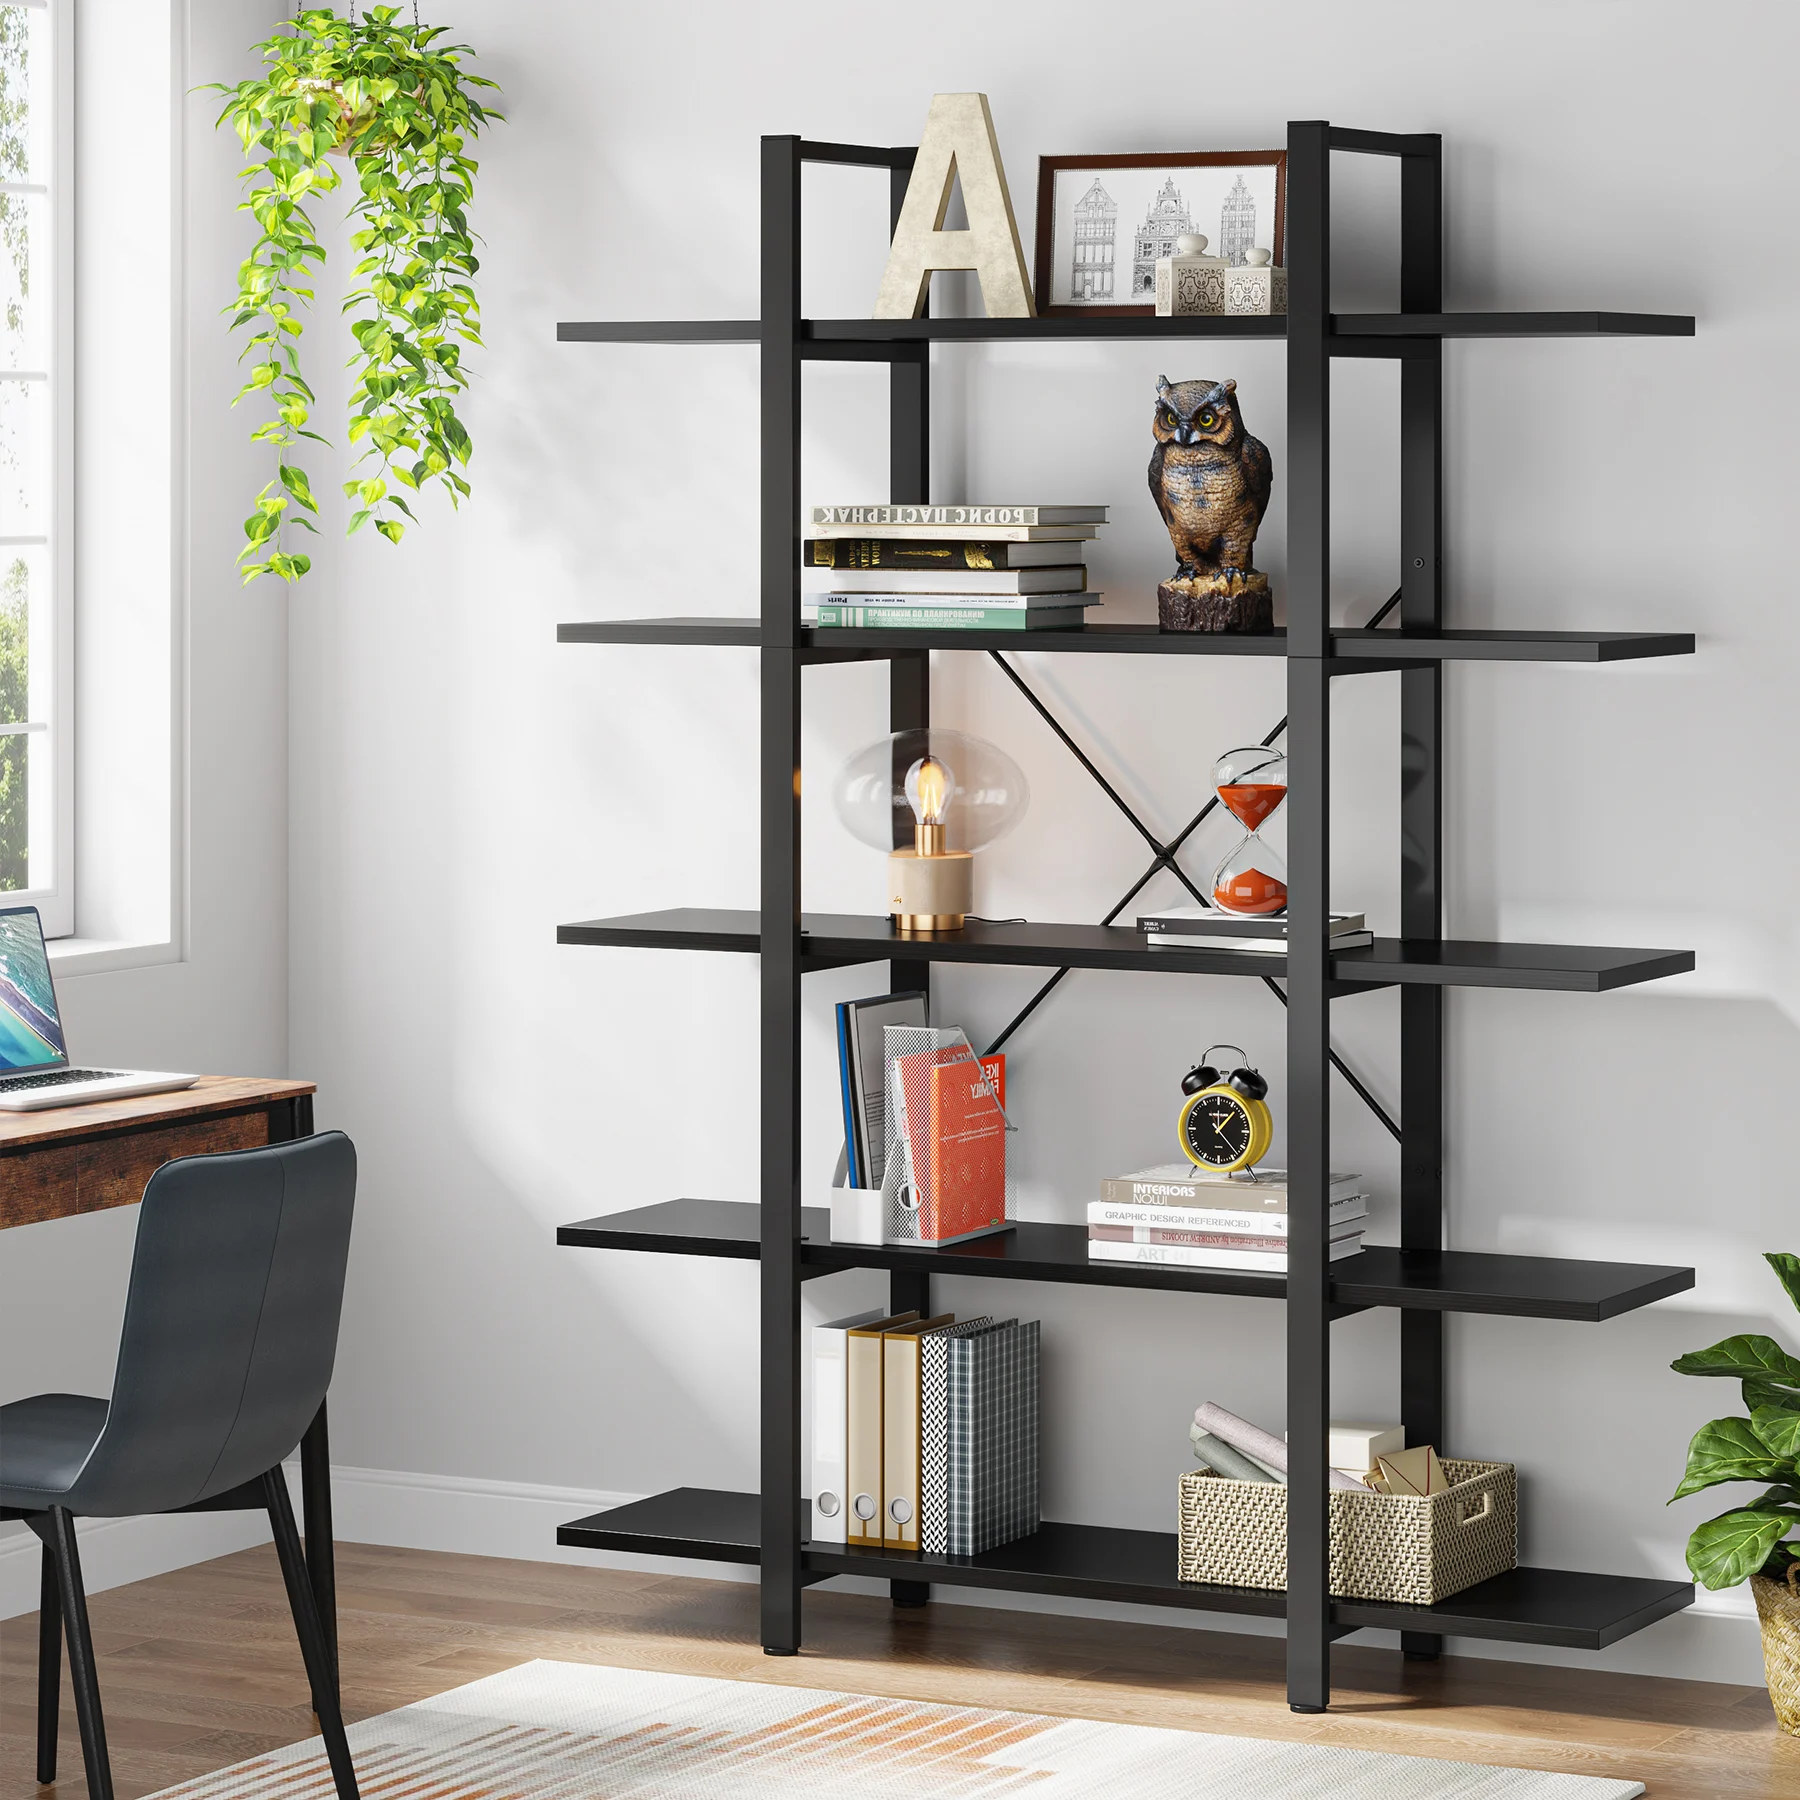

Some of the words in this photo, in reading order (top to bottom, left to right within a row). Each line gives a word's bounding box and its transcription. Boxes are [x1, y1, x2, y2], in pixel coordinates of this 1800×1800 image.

[872, 93, 1037, 318] A
[821, 508, 947, 523] ПАСТЕРНАК
[955, 508, 1025, 523] БОРИС
[868, 609, 911, 617] ПРАКТИКУМ
[912, 609, 922, 618] ПО
[1133, 1183, 1195, 1197] INTERIORS
[1105, 1211, 1147, 1222] GRAPHIC
[1150, 1214, 1185, 1224] DESIGN
[1188, 1216, 1251, 1228] REFERENCED
[1162, 1231, 1189, 1242] LOOMIS
[1190, 1234, 1220, 1244] ANDREW
[1136, 1247, 1168, 1261] ART
